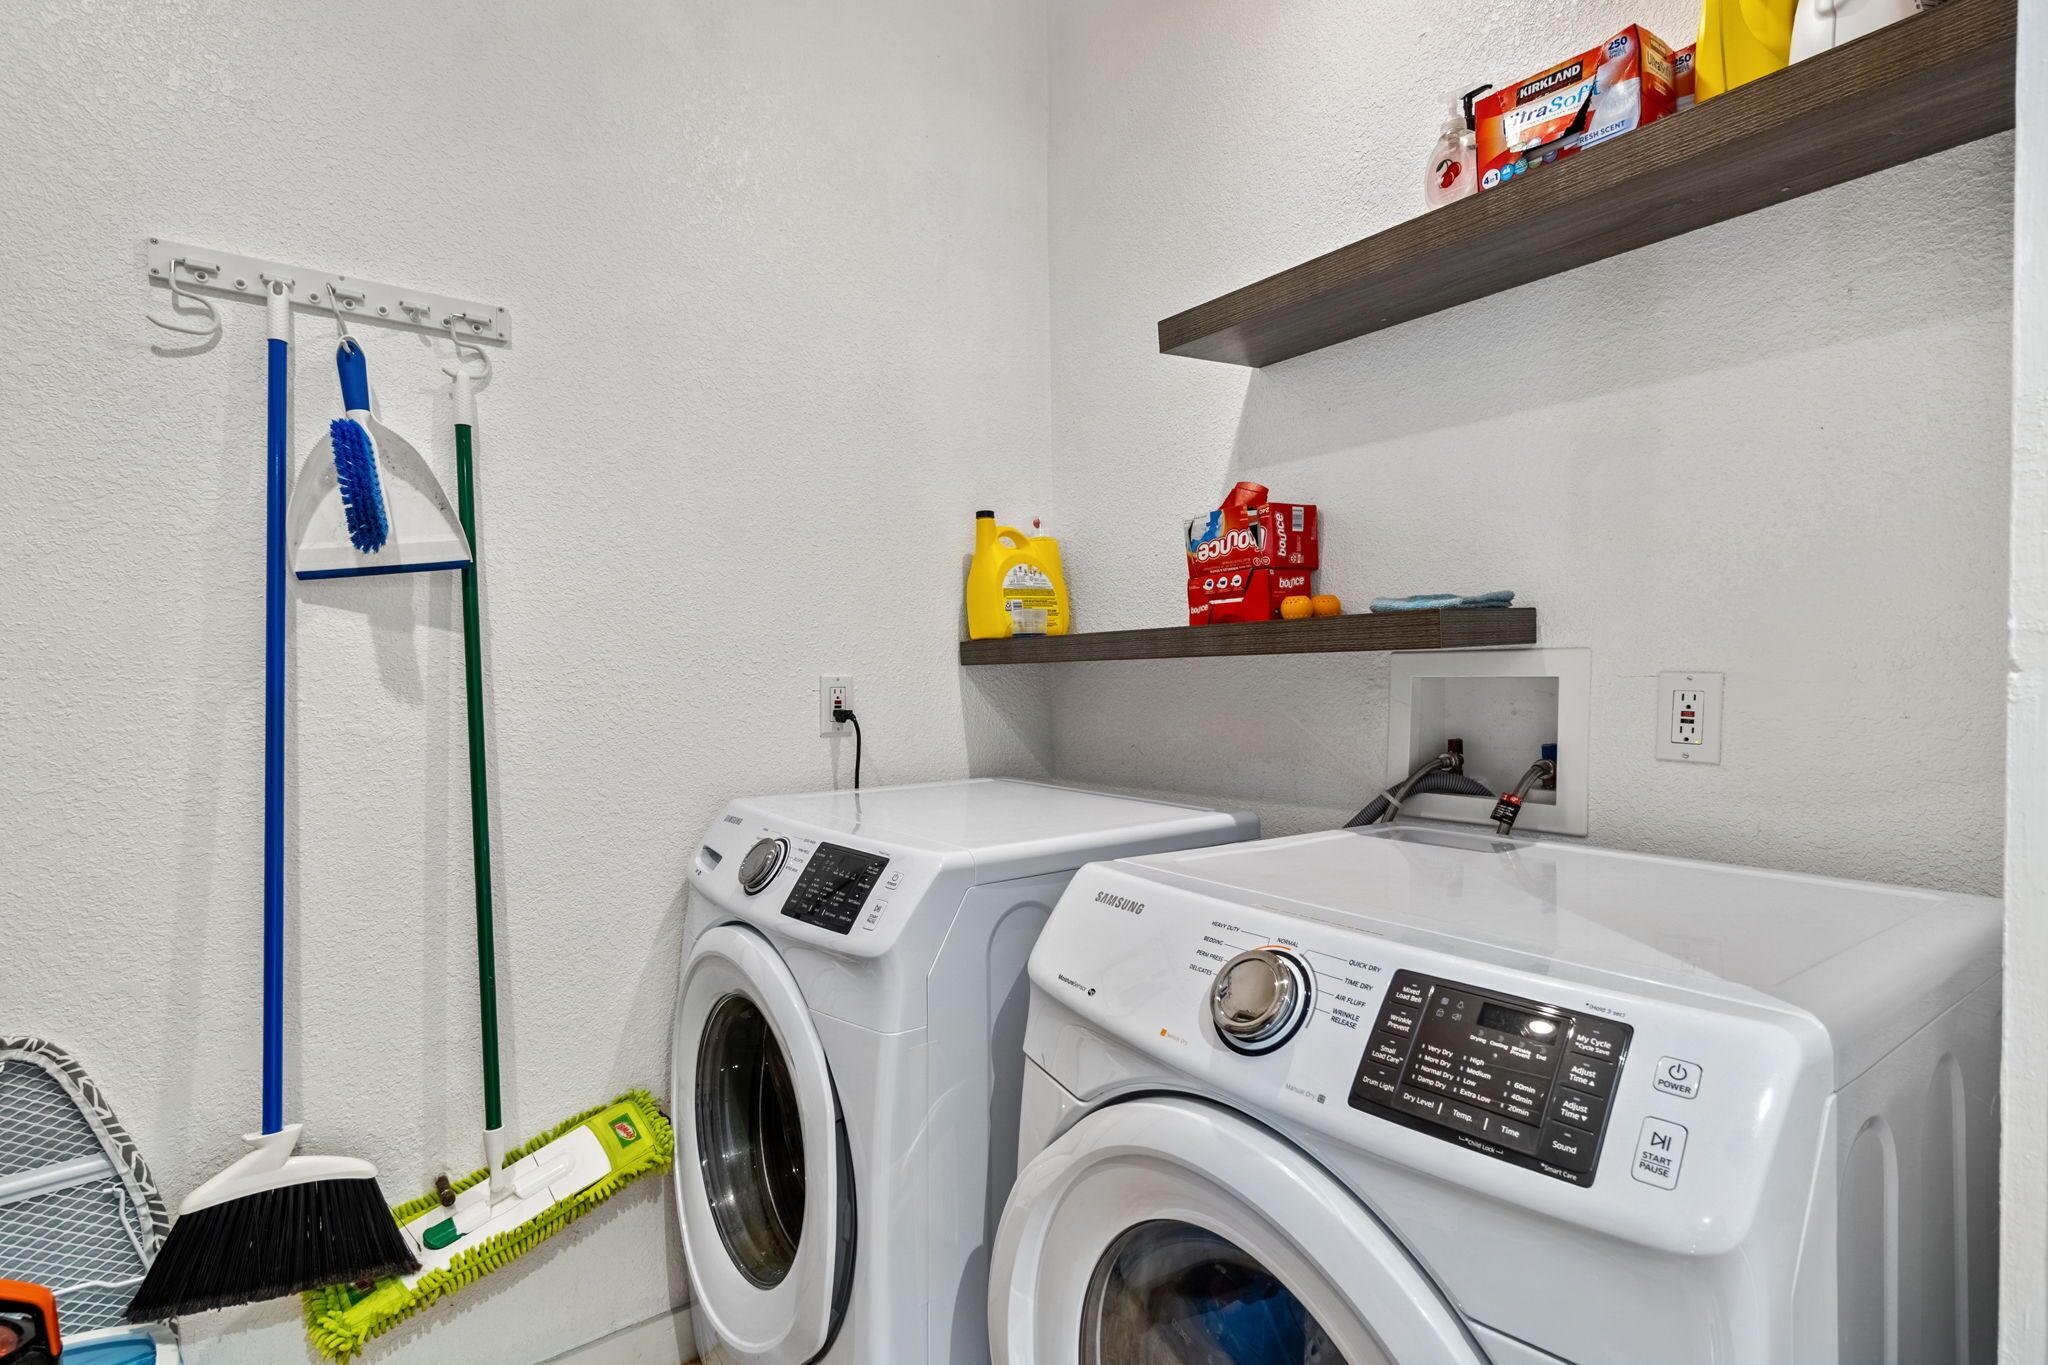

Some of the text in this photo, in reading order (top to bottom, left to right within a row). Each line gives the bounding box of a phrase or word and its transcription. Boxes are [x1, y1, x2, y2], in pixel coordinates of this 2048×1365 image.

[1608, 36, 1628, 51] 250
[1519, 64, 1581, 99] KIRKLAND
[1578, 120, 1626, 144] RESH SCENT
[1275, 512, 1287, 557] bounce
[1279, 576, 1305, 589] bounce
[1190, 604, 1209, 614] bounce
[1095, 891, 1145, 915] SAMSUNG
[1212, 921, 1240, 932] HEAVY DUTY
[1203, 935, 1224, 946] BEDDING
[1277, 937, 1299, 948] NORMAL
[1196, 949, 1224, 962] PERM PRESS
[1189, 963, 1213, 976] DELICATES
[1348, 959, 1382, 973] QUICK DRY
[1344, 977, 1373, 991] TIME DRY
[1395, 991, 1422, 1004] Load Bell
[1402, 986, 1421, 996] Mixed
[1335, 994, 1367, 1008] AIR FLUFF
[1332, 1008, 1360, 1022] WRINKLE
[1390, 1013, 1413, 1026] Wrinkle
[1331, 1015, 1358, 1030] RELEASE
[1387, 1020, 1410, 1033] Prevent
[1469, 1034, 1487, 1045] Drying
[1489, 1040, 1509, 1051] Cooling
[1576, 1034, 1612, 1050] My Cycle
[1371, 1050, 1386, 1060] Load
[1380, 1045, 1397, 1055] Small
[1428, 1044, 1454, 1058] Very Dry
[1594, 1047, 1611, 1056] Save
[1424, 1055, 1452, 1069] More Dry
[1469, 1056, 1485, 1066] High
[1535, 1053, 1547, 1062] End
[1420, 1065, 1455, 1081] Normal Dry
[1466, 1067, 1492, 1080] Medium
[1570, 1065, 1597, 1079] Adjust
[1362, 1075, 1395, 1093] Drum Light
[1417, 1075, 1447, 1090] Damp Dry
[1462, 1077, 1477, 1087] Low
[1569, 1073, 1589, 1085] Time
[1513, 1082, 1536, 1095] 60min
[1657, 1079, 1692, 1095] POWER
[1403, 1092, 1435, 1109] Dry Level
[1459, 1088, 1492, 1104] Extra Low
[1510, 1093, 1533, 1106] 40min
[1507, 1104, 1530, 1117] 20min
[1562, 1100, 1588, 1114] Adjust
[1452, 1108, 1473, 1123] Temp.
[1561, 1108, 1580, 1121] Time
[1500, 1125, 1520, 1138] Time
[1482, 1144, 1496, 1154] Lock
[1552, 1140, 1577, 1155] Sound
[1642, 1150, 1673, 1167] START
[1562, 1171, 1578, 1181] Care
[1638, 1161, 1670, 1178] PAUSE
